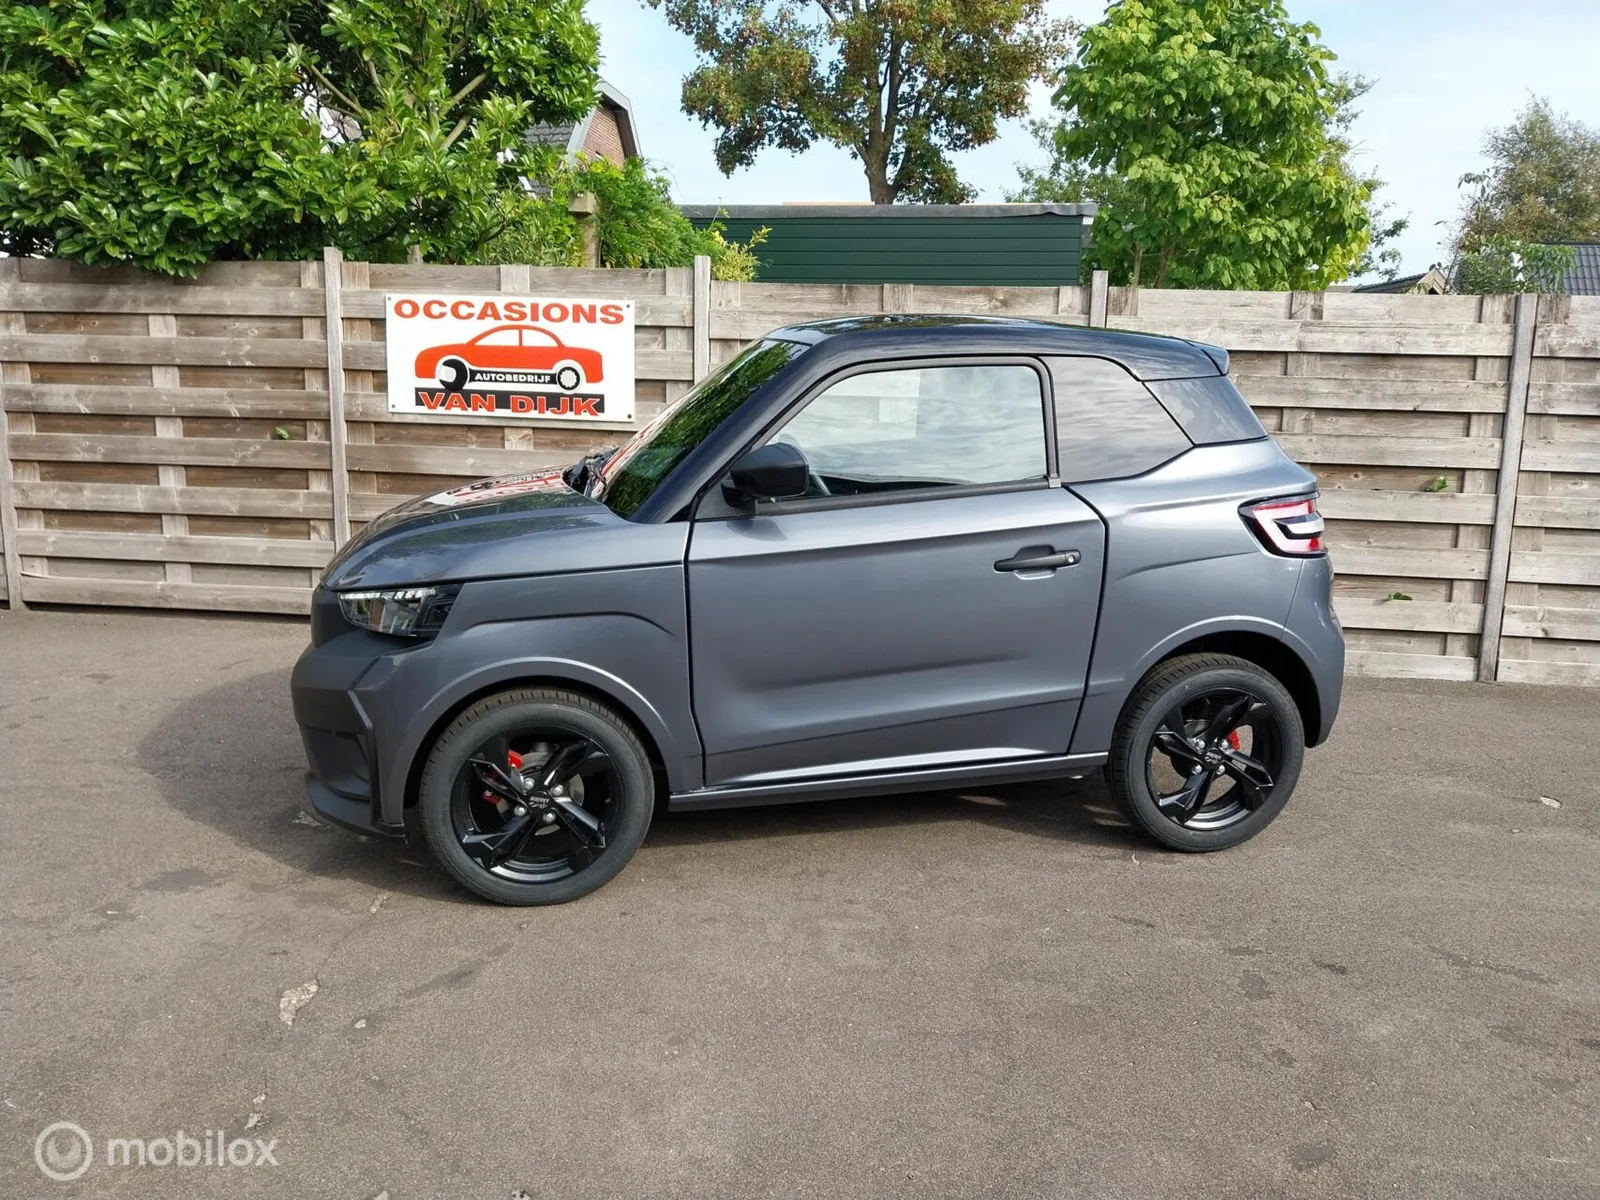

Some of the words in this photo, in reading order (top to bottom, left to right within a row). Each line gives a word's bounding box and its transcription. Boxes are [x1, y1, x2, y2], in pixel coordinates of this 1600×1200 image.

[394, 299, 625, 325] OCCASIONS
[474, 372, 551, 383] AUTOBEDRIJF
[418, 391, 497, 412] VAN
[510, 395, 601, 417] DIJK
